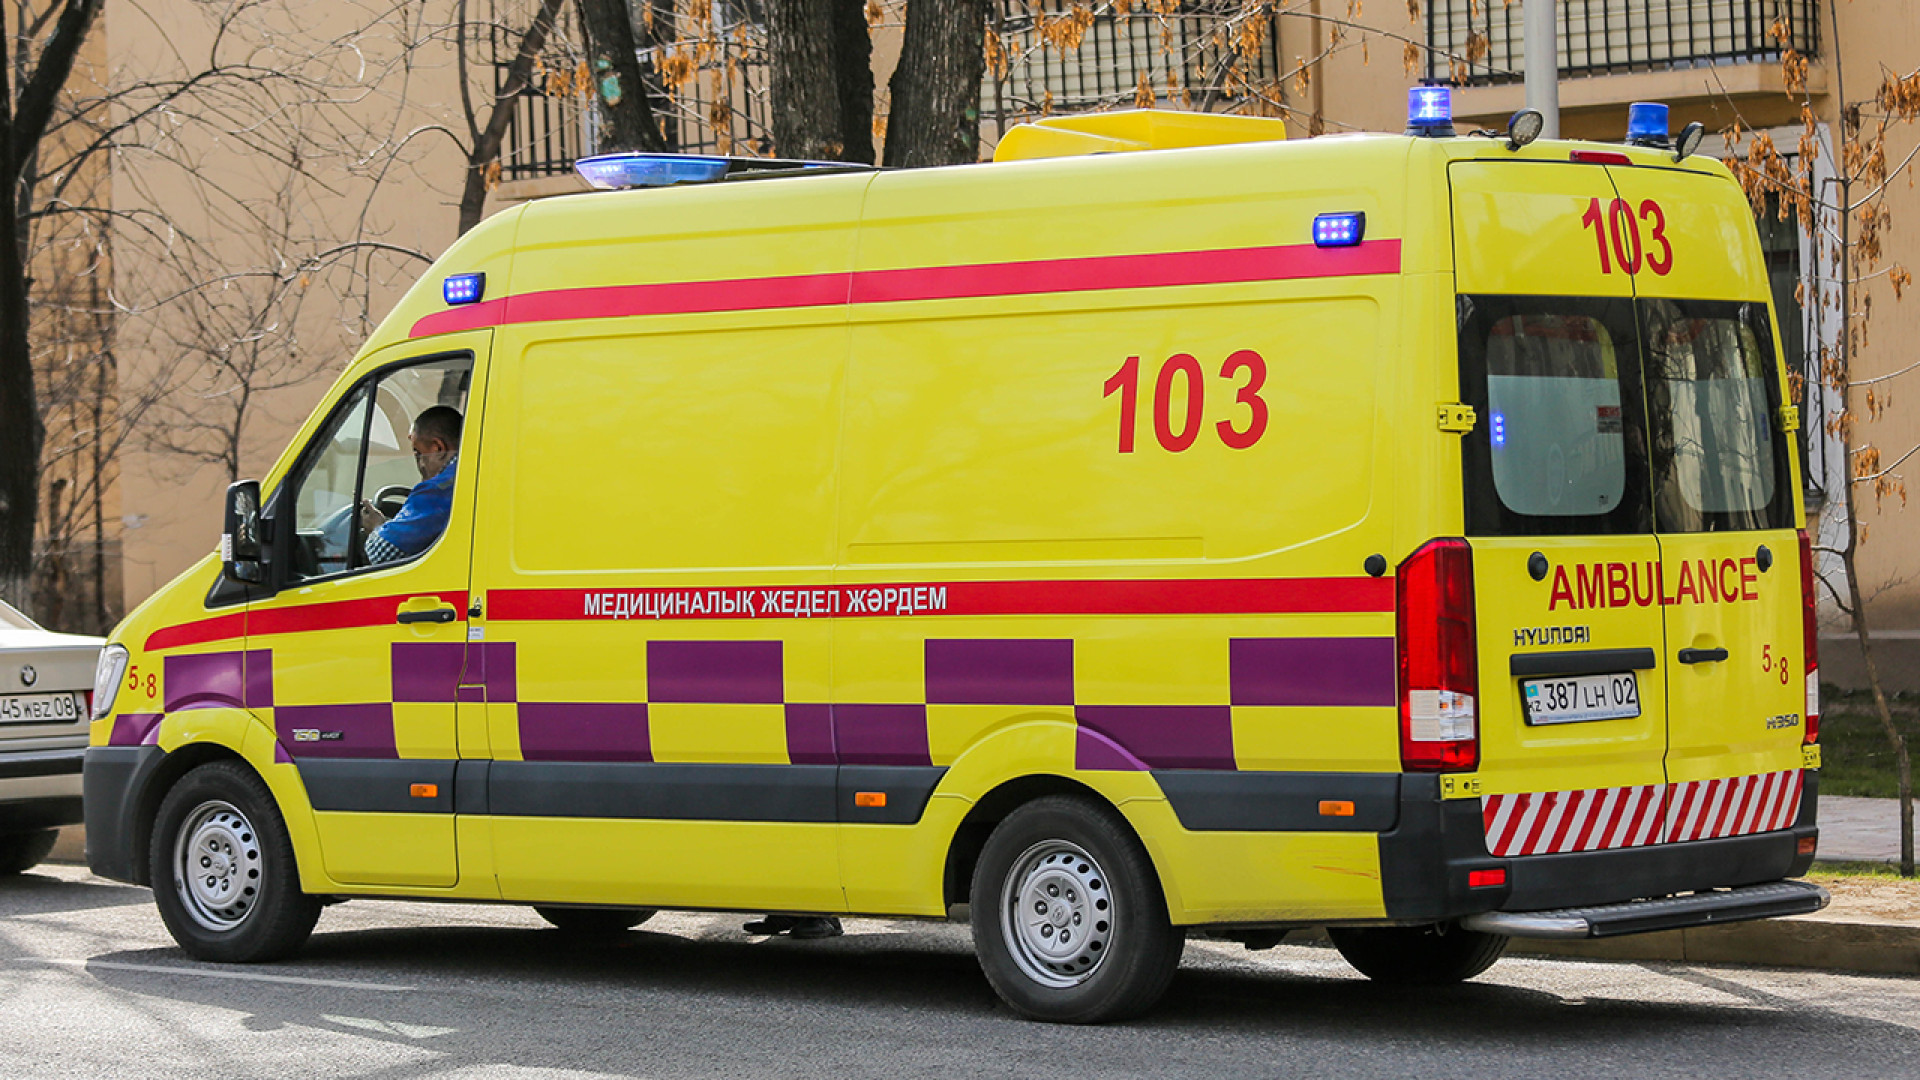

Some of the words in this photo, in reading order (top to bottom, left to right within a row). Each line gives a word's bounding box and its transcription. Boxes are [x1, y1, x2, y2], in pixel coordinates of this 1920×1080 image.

[1581, 197, 1674, 277] 103
[1102, 348, 1270, 454] 103
[1549, 557, 1759, 611] AMBULANCE
[584, 590, 756, 620] МЕДИЦИНАЛЫҚ
[760, 589, 840, 618] ЖЕДЕЛ
[846, 586, 947, 616] ЖӘРДЕМ
[1513, 625, 1591, 646] HYUNDAI
[0, 698, 22, 719] 45
[54, 696, 74, 717] 08
[1544, 681, 1578, 711] 387
[1583, 685, 1607, 709] LH
[1613, 677, 1636, 705] 02
[1766, 713, 1800, 730] H350
